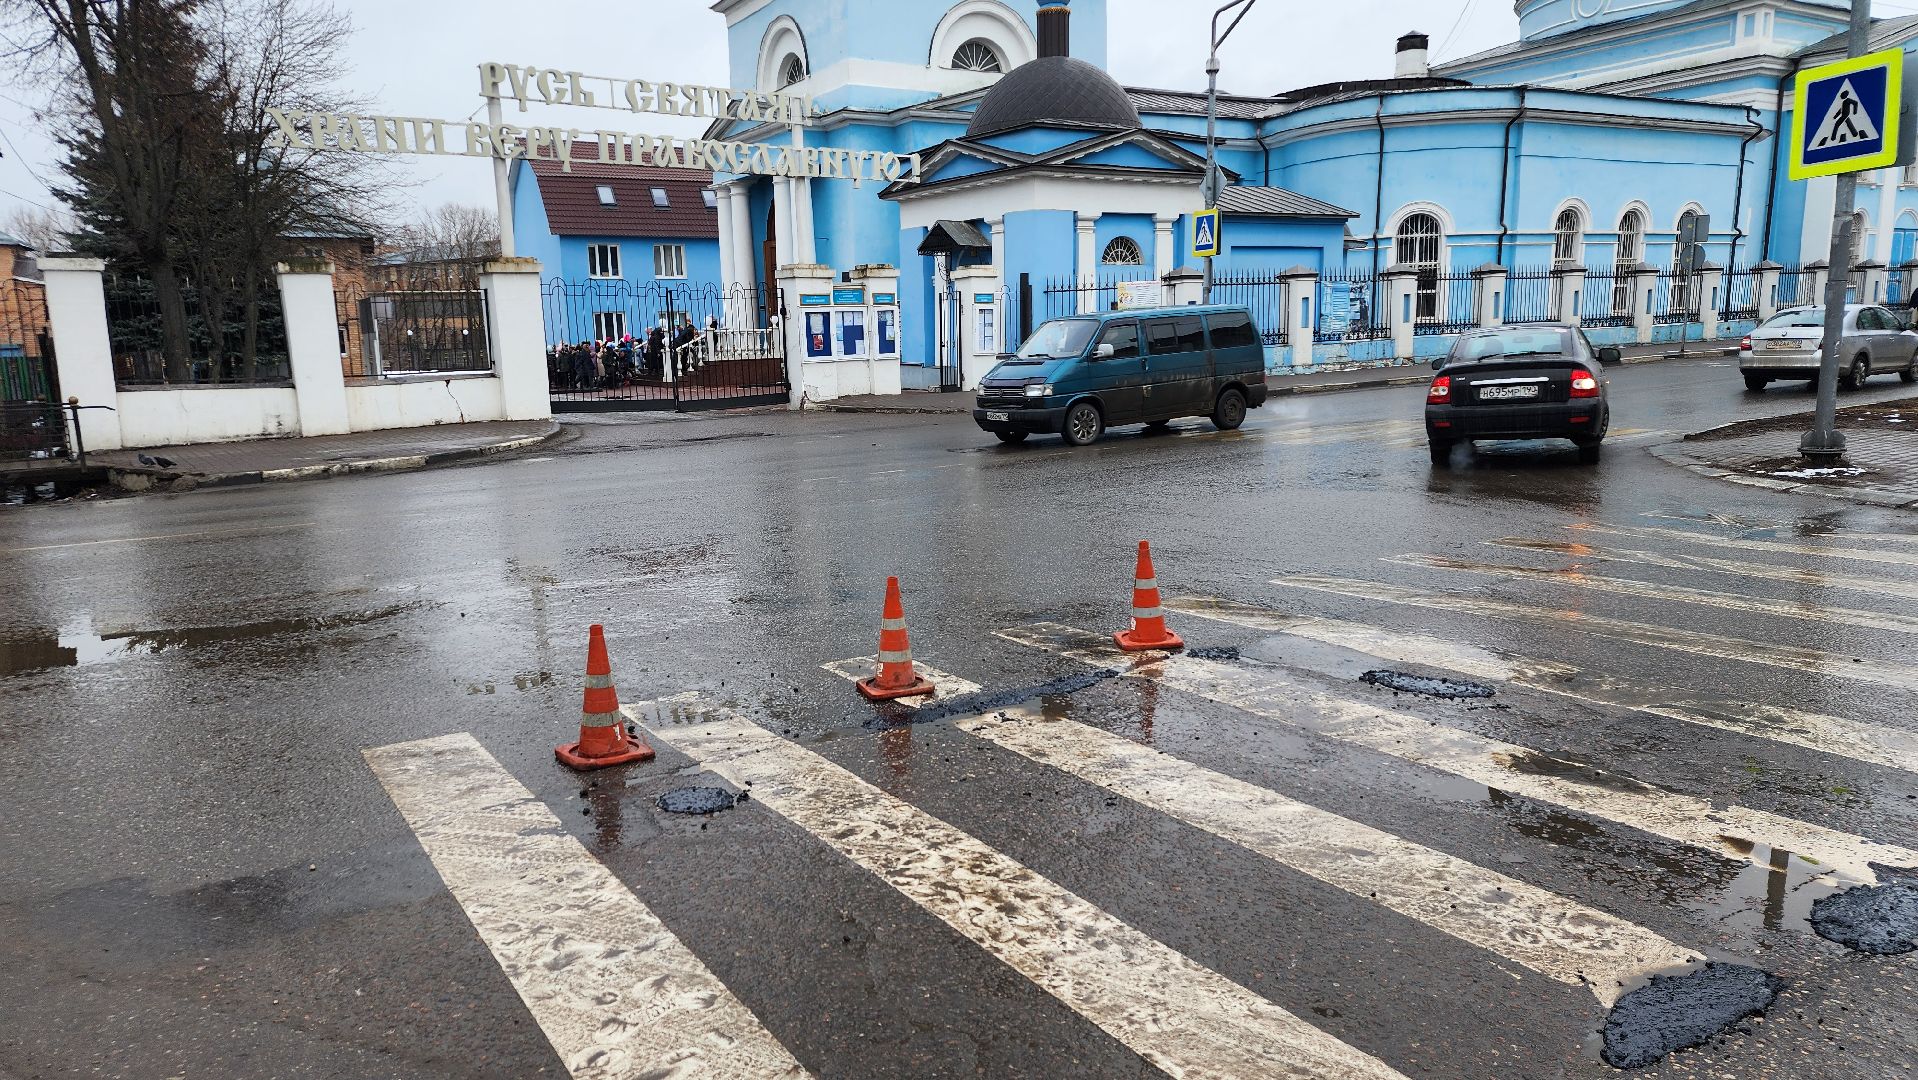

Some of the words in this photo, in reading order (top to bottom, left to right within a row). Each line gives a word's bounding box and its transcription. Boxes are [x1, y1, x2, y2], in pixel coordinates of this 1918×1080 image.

[480, 62, 594, 112] РУСЬ
[625, 79, 813, 126] СВЯТАЯ!
[264, 106, 446, 155] ХРАНИ
[465, 122, 580, 173] ВЕРУ
[595, 129, 921, 189] ПРАВОСЛАВНУЮ!
